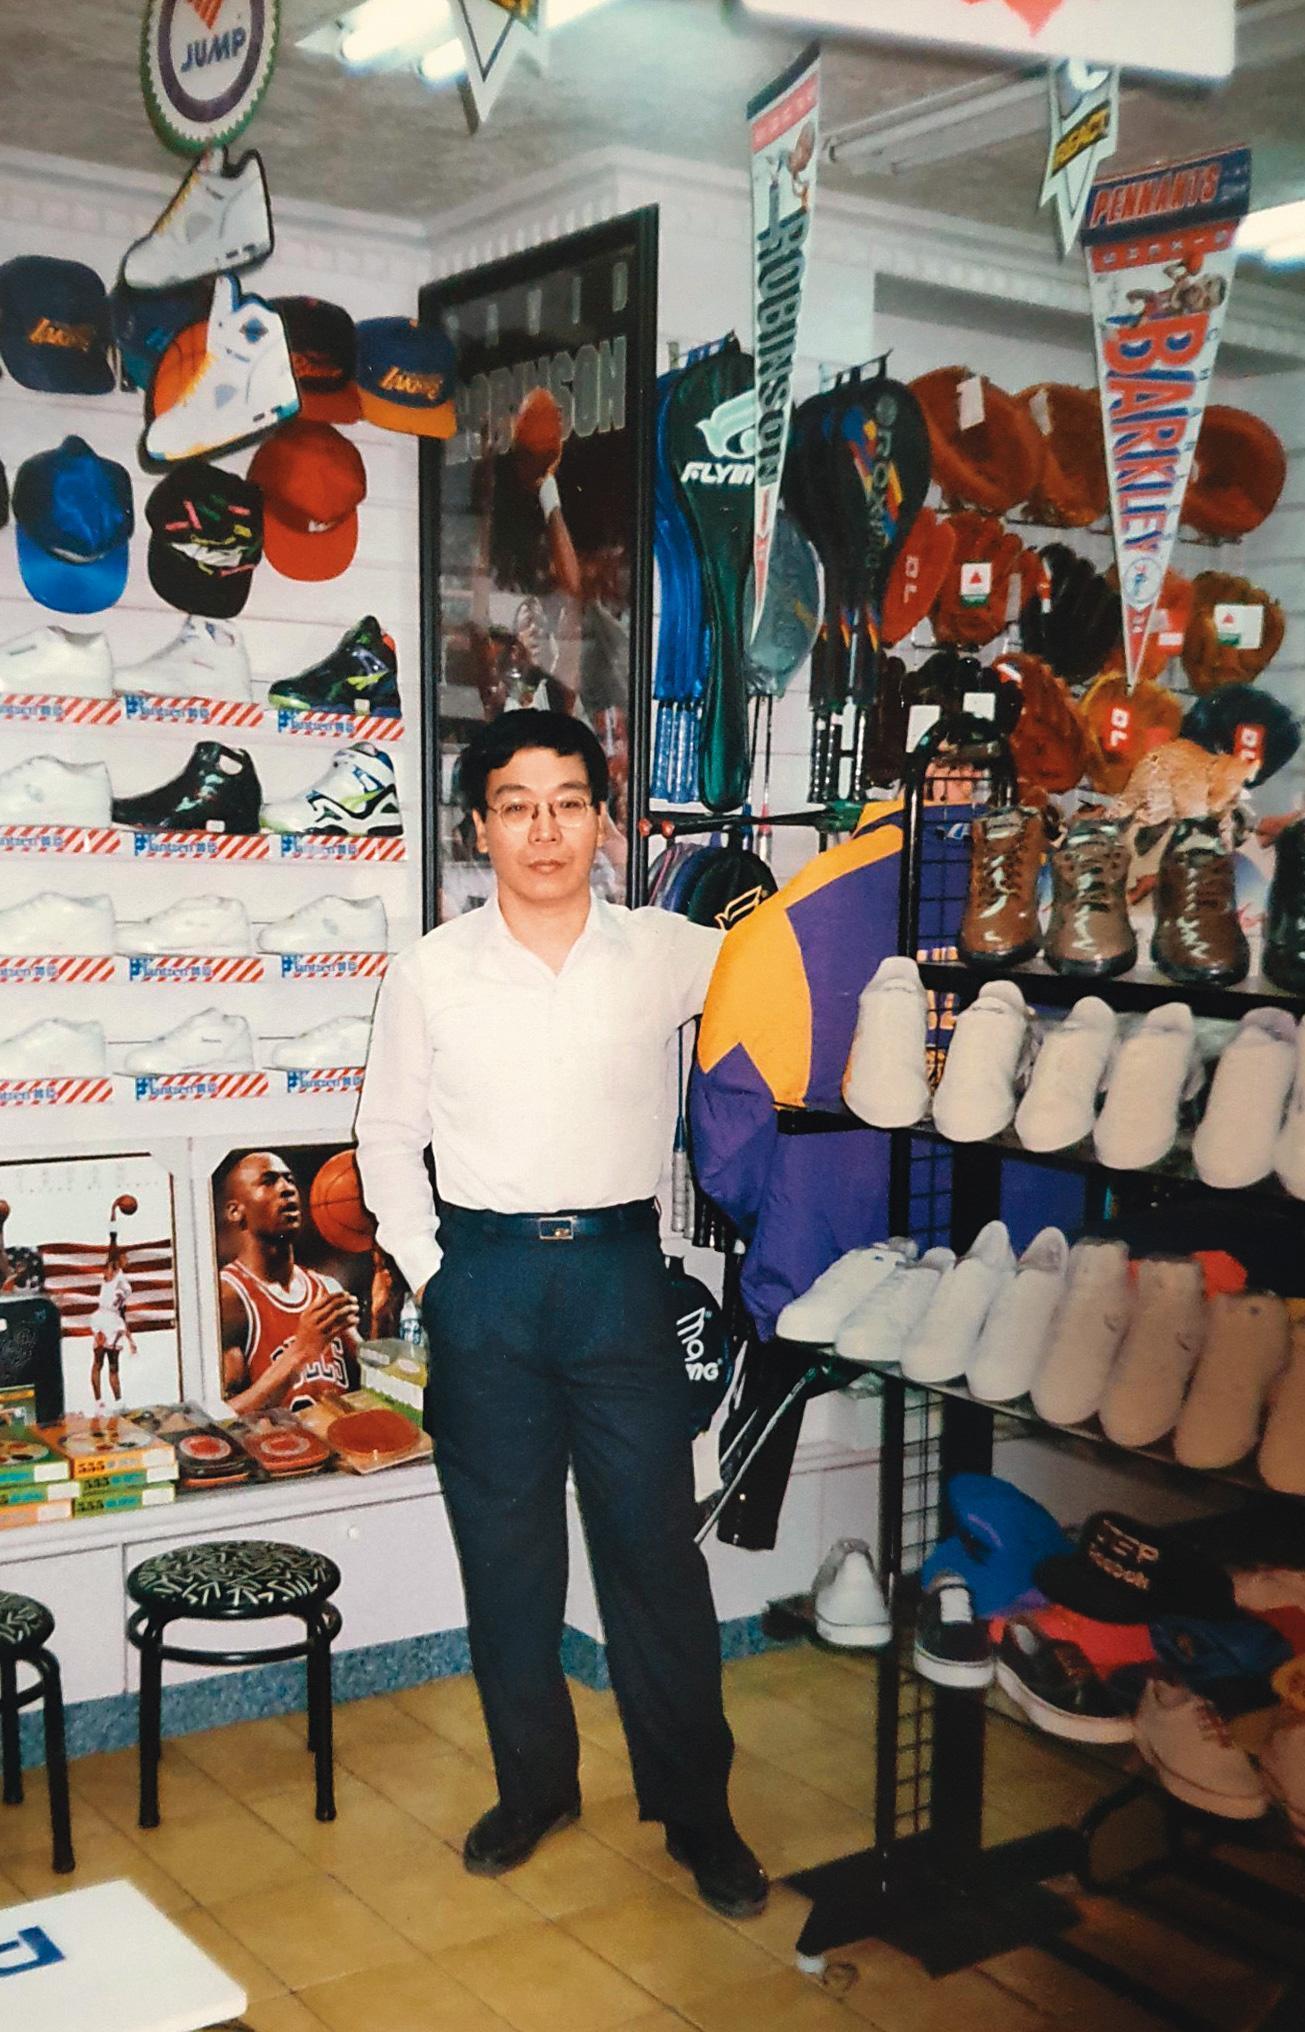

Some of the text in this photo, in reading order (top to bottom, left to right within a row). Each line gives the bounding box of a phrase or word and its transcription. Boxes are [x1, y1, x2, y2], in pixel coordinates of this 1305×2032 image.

[181, 26, 247, 73] JUMP
[757, 205, 809, 487] ROBINSON
[1103, 309, 1210, 554] BARKLEY
